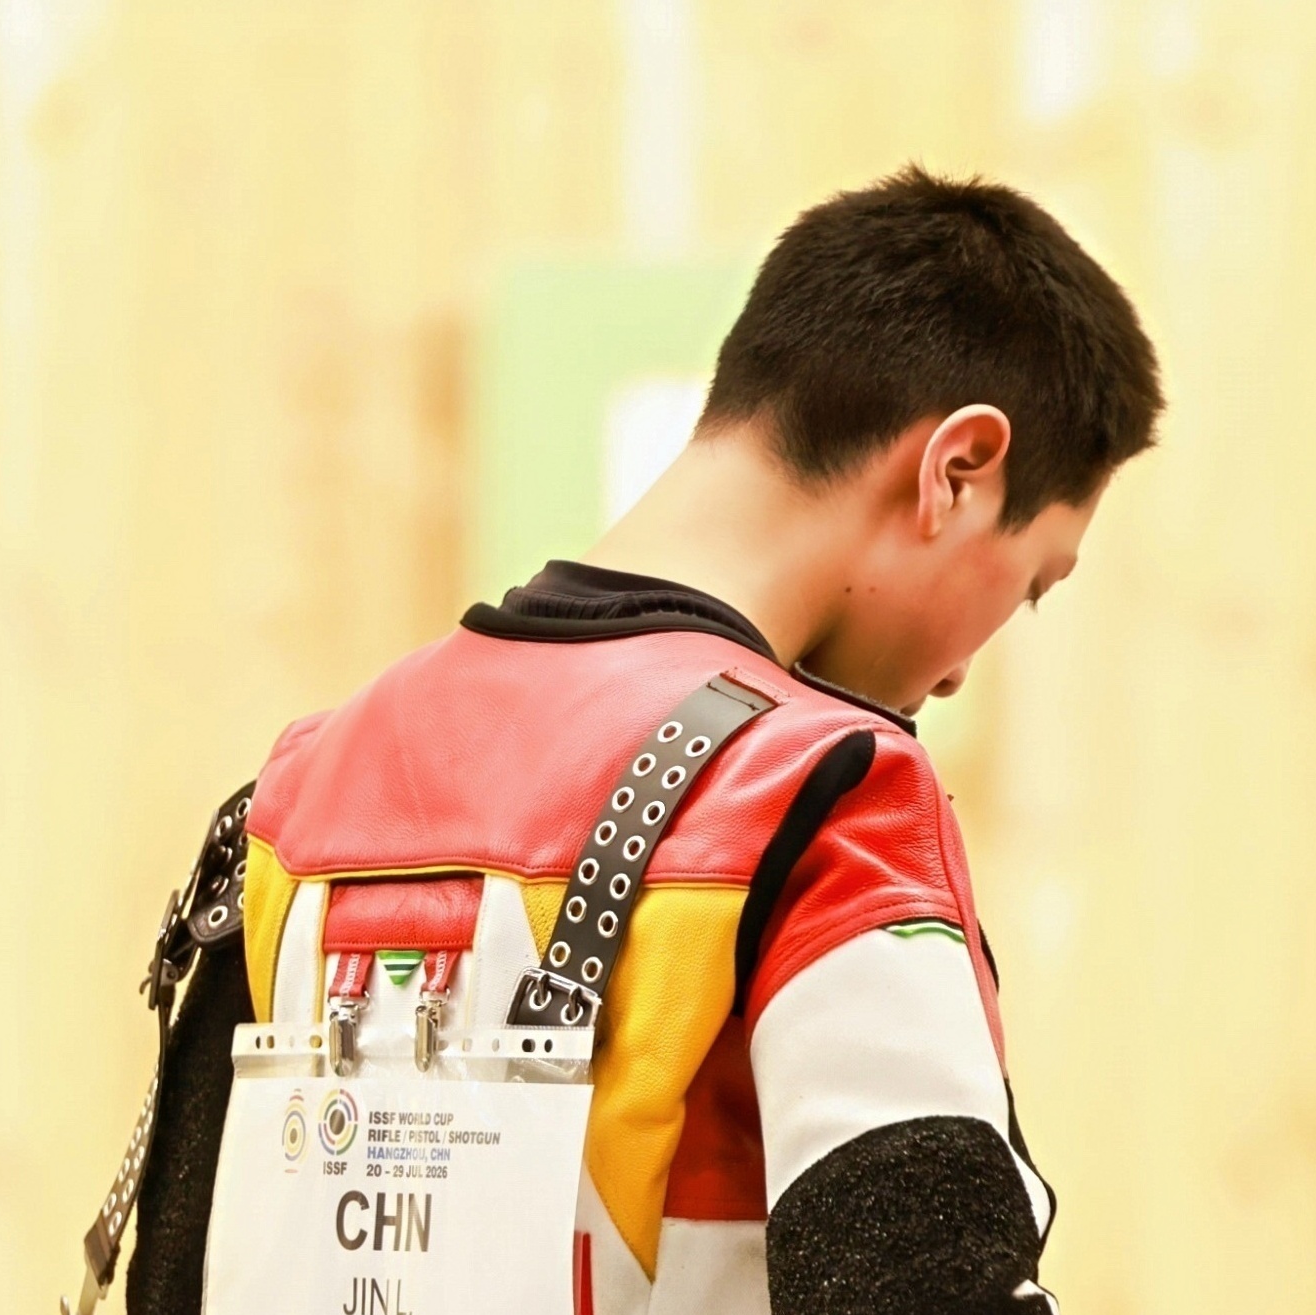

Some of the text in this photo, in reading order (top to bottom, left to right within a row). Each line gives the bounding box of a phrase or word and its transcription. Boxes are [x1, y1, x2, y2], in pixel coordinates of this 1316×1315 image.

[369, 1112, 454, 1126] ISSF WORLD CUP
[368, 1129, 401, 1143] RIFLE
[409, 1131, 440, 1144] PISTOL
[448, 1132, 501, 1145] SHOTGUN
[367, 1147, 451, 1162] HANGZHOU, CHN
[323, 1161, 348, 1175] ISSF
[366, 1164, 382, 1177] 20
[393, 1165, 404, 1178] 29
[406, 1165, 424, 1179] JUL
[426, 1165, 448, 1179] 2026
[336, 1190, 432, 1252] CHN
